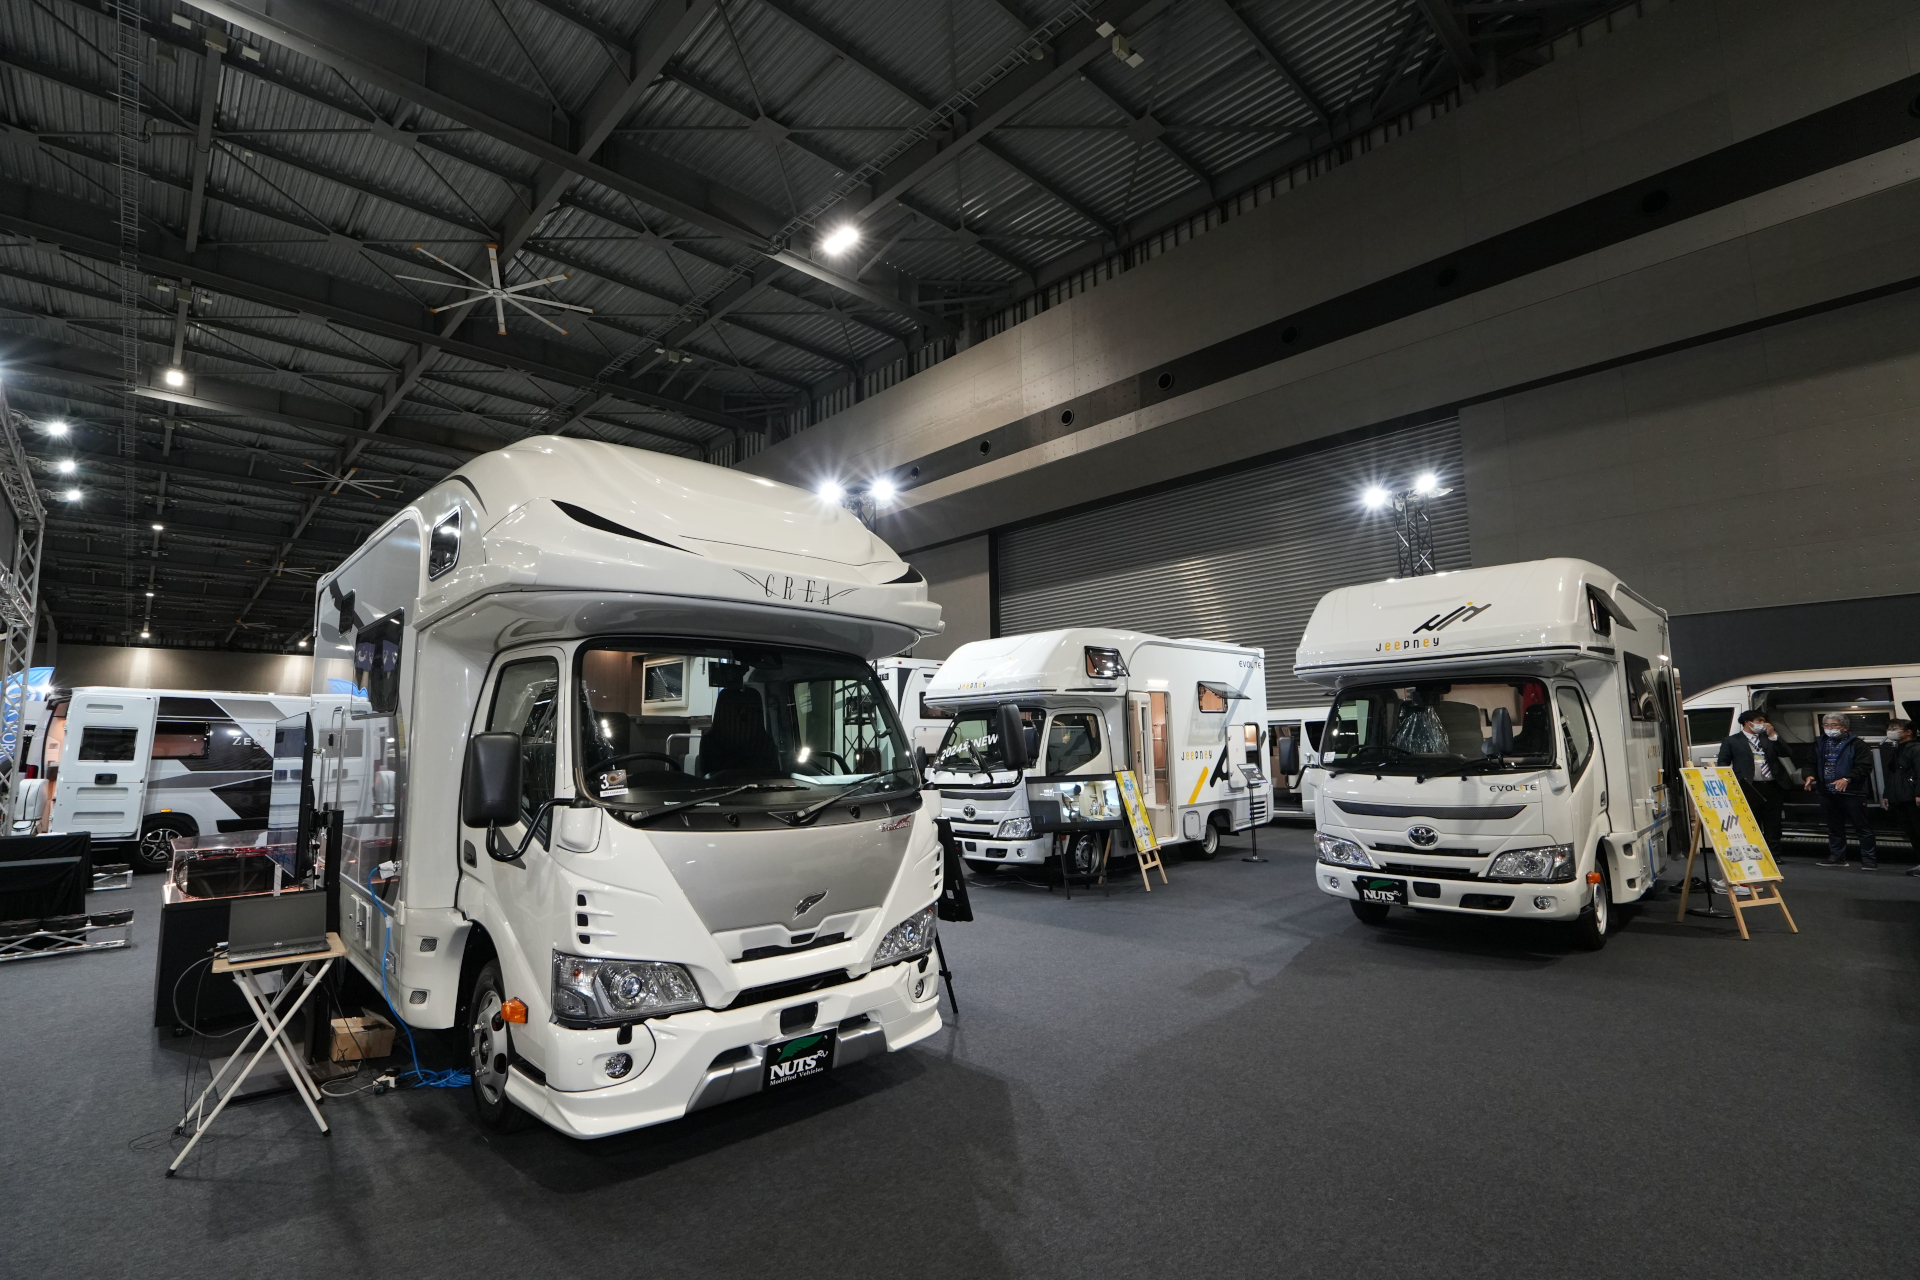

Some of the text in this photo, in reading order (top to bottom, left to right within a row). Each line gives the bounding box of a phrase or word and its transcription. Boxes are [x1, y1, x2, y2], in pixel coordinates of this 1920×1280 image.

[765, 573, 831, 605] CREA
[1702, 780, 1728, 796] NEW
[769, 1055, 817, 1080] NUTS
[769, 1066, 824, 1086] Modified Vehicles
